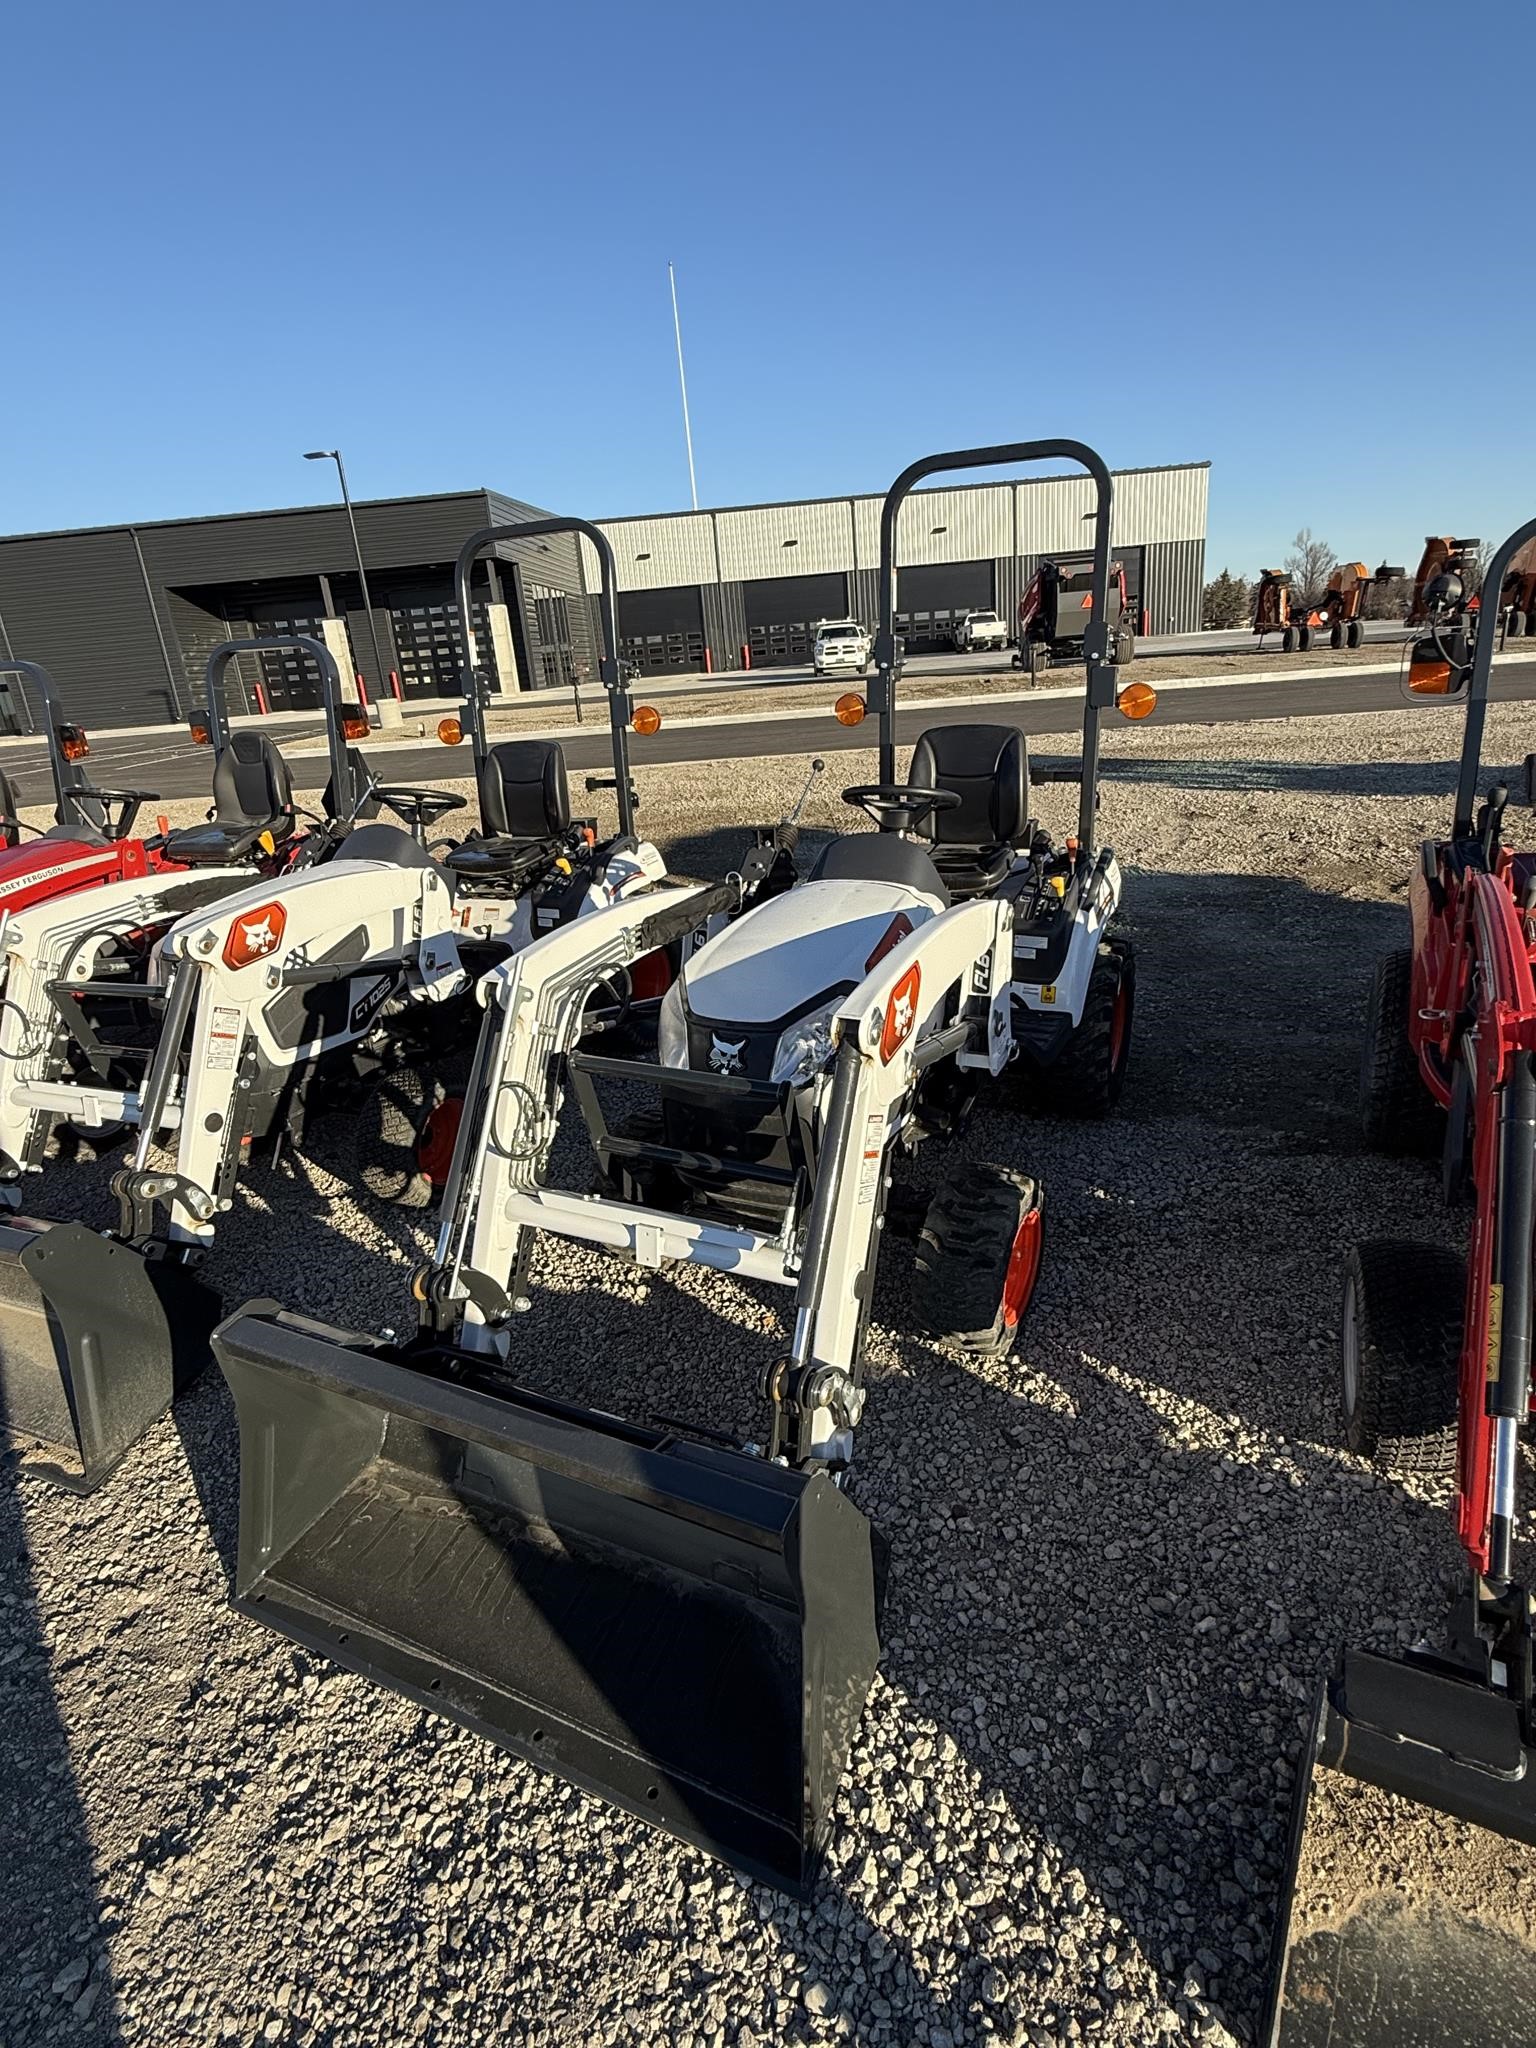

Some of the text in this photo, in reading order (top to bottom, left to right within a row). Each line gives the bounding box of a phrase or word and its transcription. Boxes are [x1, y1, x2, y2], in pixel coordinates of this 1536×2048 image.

[0, 866, 64, 894] SSEY FERGUSON
[355, 976, 391, 1020] CT1025
